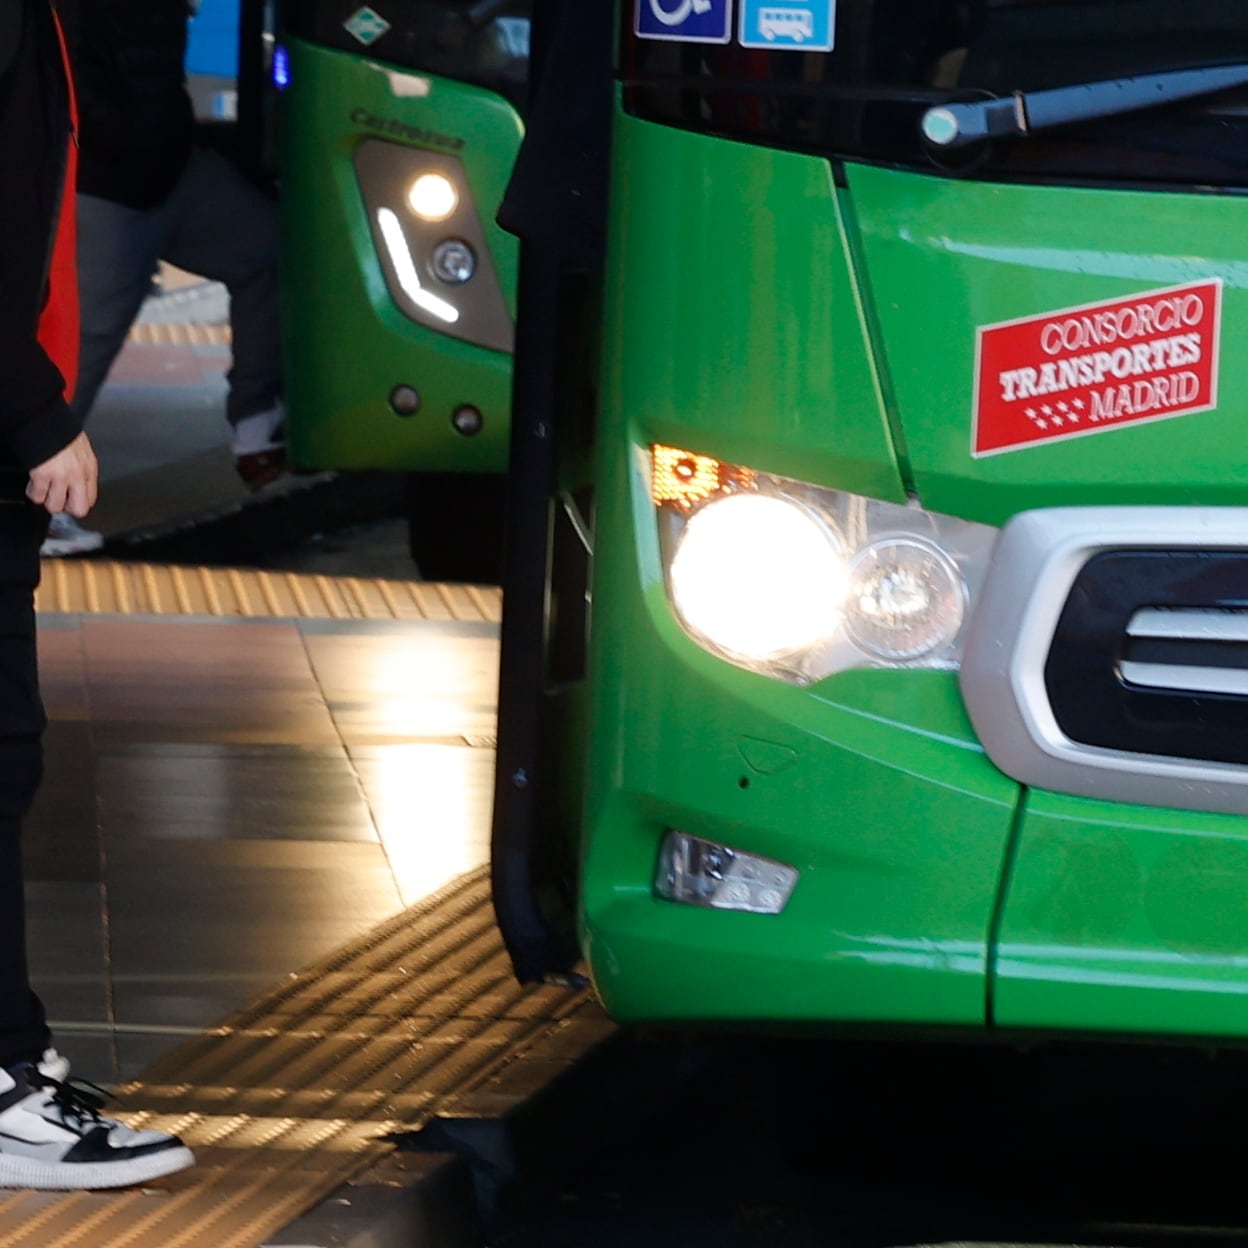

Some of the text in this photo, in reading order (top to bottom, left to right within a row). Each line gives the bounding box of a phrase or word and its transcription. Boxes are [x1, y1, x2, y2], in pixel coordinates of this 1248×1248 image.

[1040, 293, 1204, 355] CONSORCIO
[999, 331, 1202, 403] TRANSPORTES
[1088, 370, 1200, 422] MADRID
